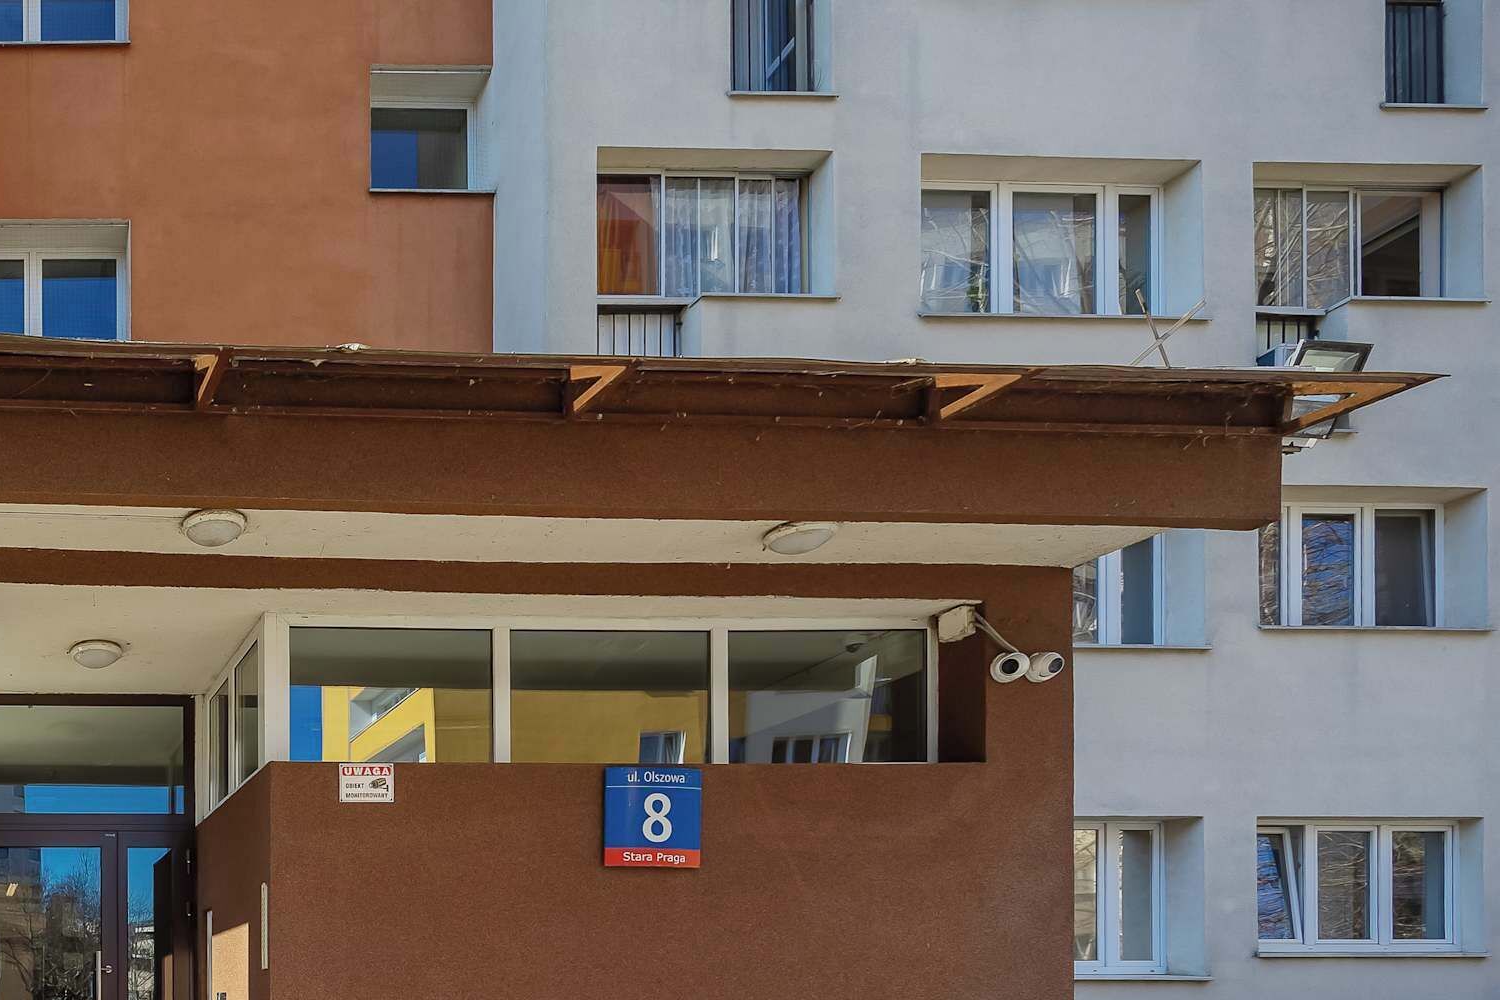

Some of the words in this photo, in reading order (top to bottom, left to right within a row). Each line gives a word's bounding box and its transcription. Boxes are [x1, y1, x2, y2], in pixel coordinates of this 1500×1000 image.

[343, 767, 390, 776] UWAGA
[627, 771, 640, 782] ul.
[643, 771, 686, 783] Olszowa
[642, 792, 673, 843] 8
[622, 851, 653, 862] Stara
[656, 852, 686, 864] Praga
